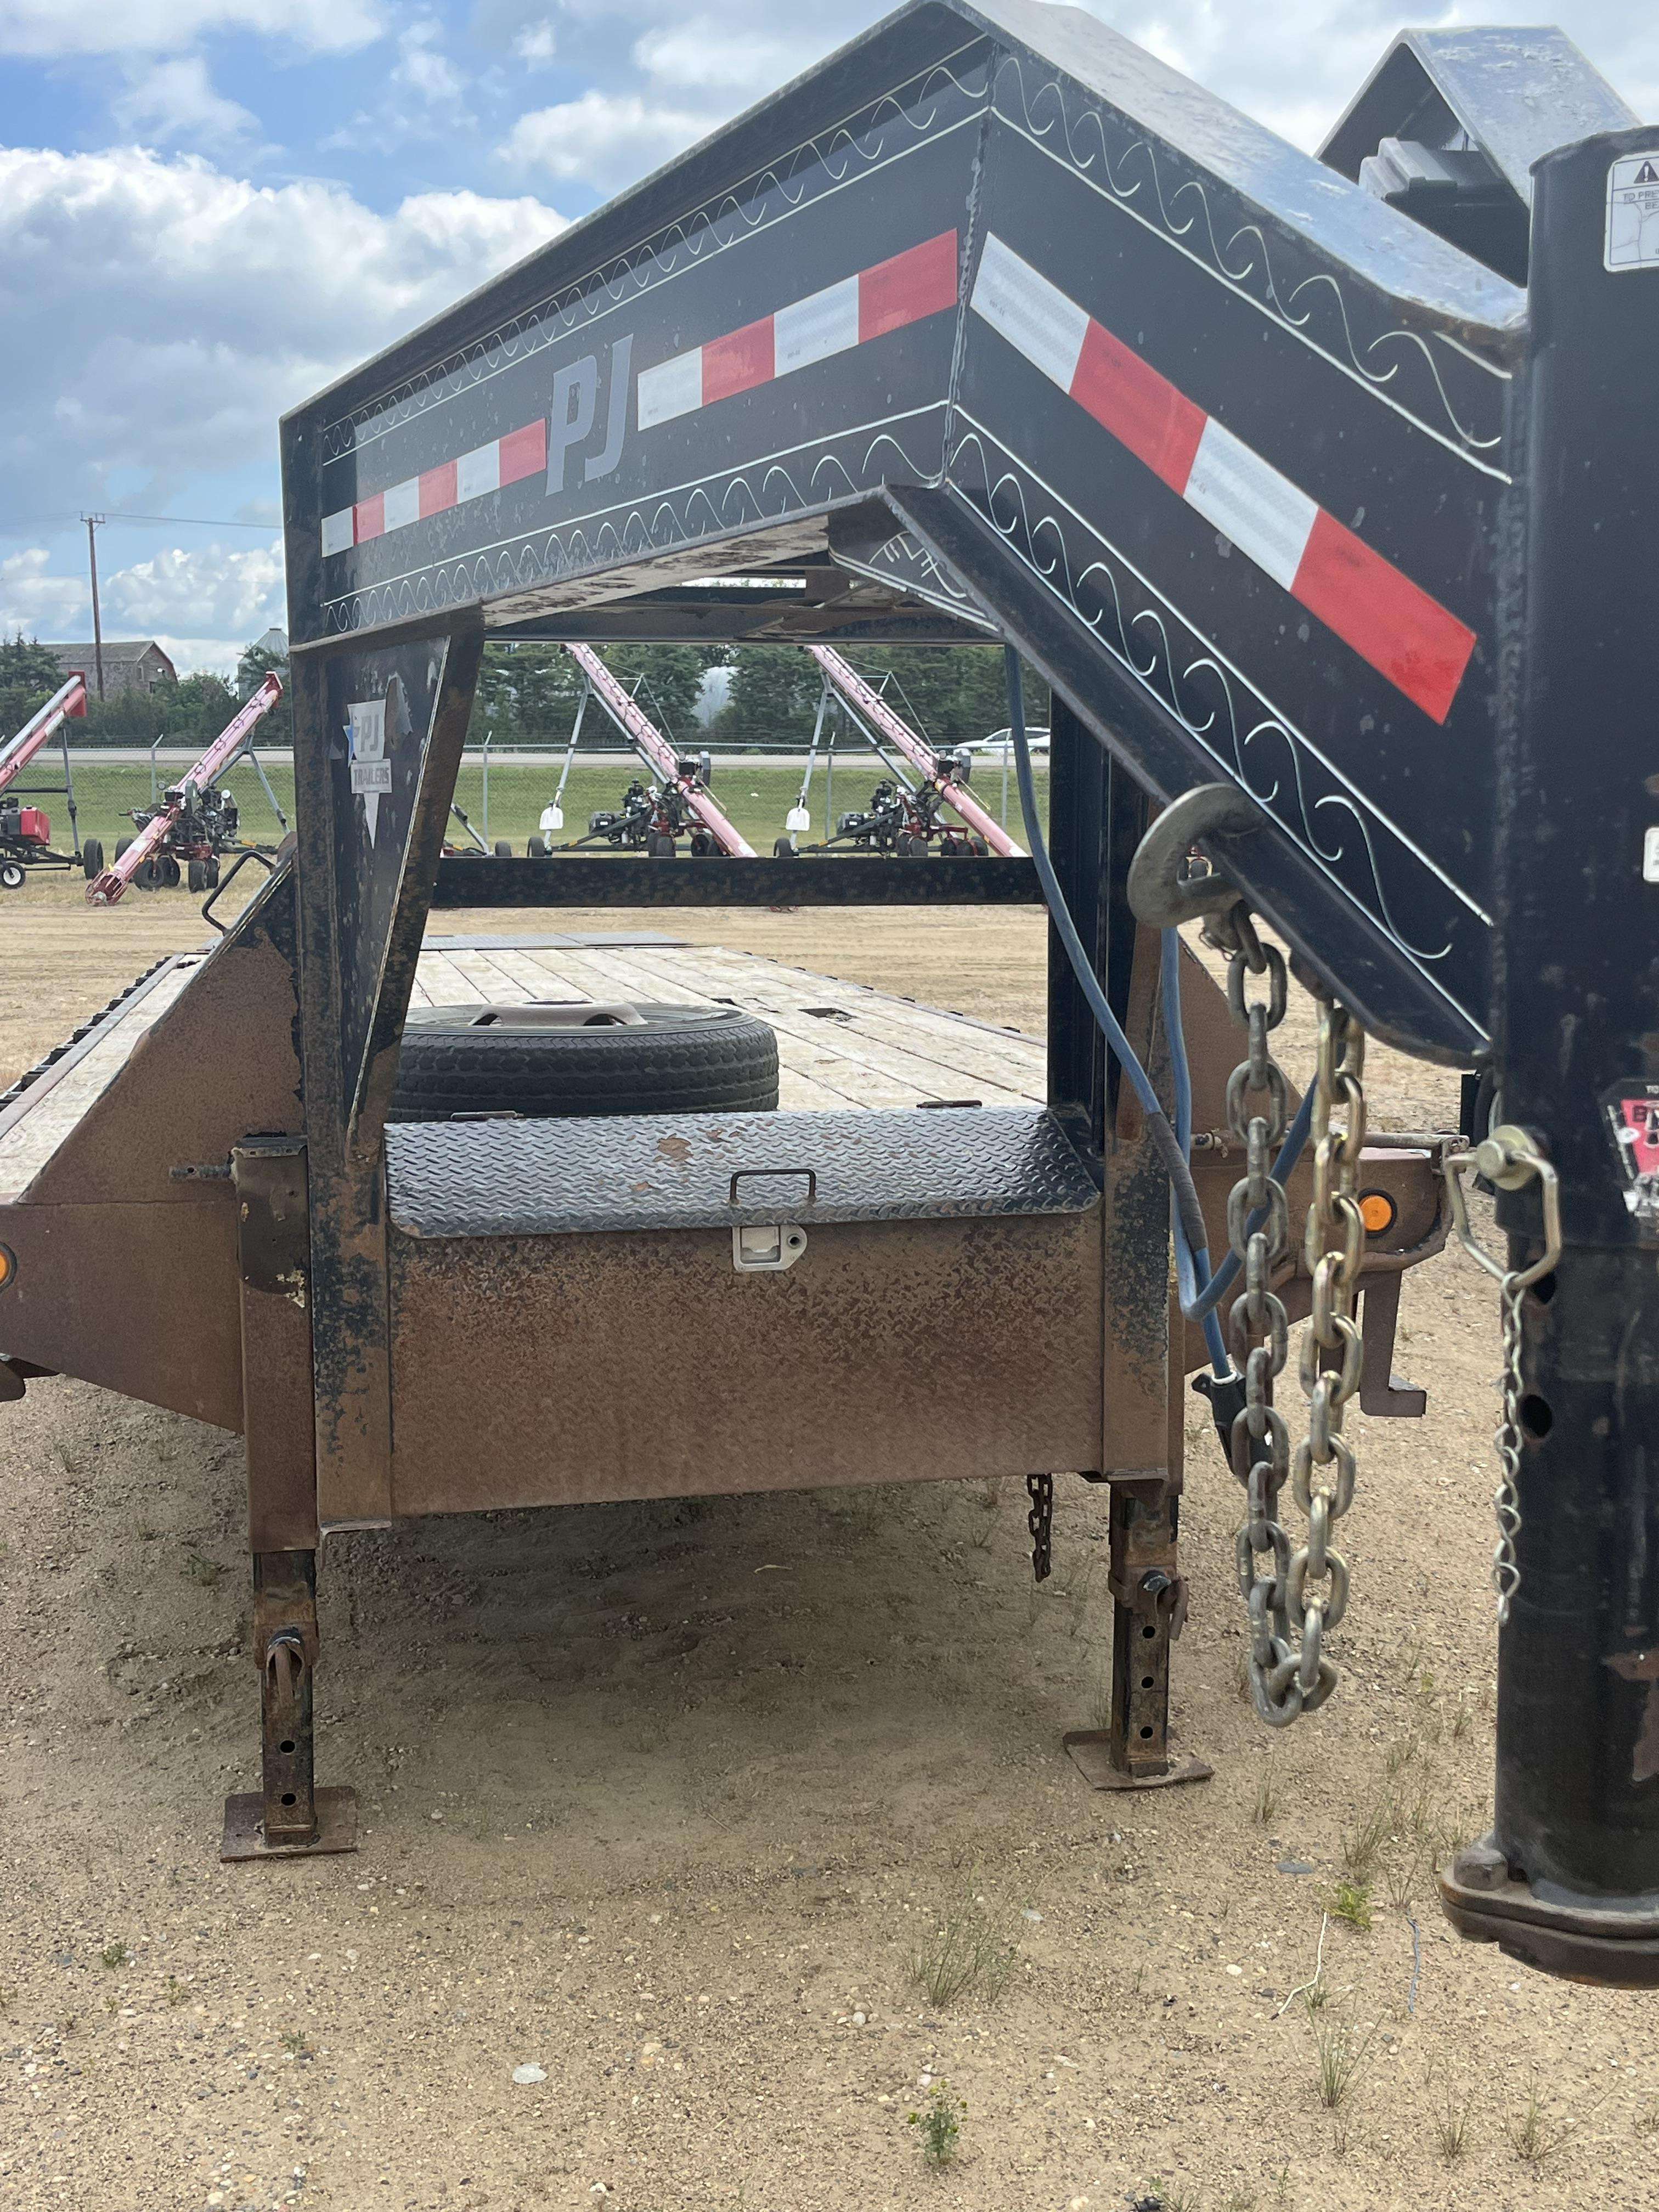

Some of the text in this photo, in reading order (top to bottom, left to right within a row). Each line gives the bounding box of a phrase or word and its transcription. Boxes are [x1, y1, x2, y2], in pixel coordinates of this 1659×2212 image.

[1623, 190, 1659, 202] TO PRE
[1645, 201, 1659, 209] BE
[545, 333, 634, 496] PJ
[360, 714, 379, 752] PJ
[354, 768, 390, 786] TRAILERS
